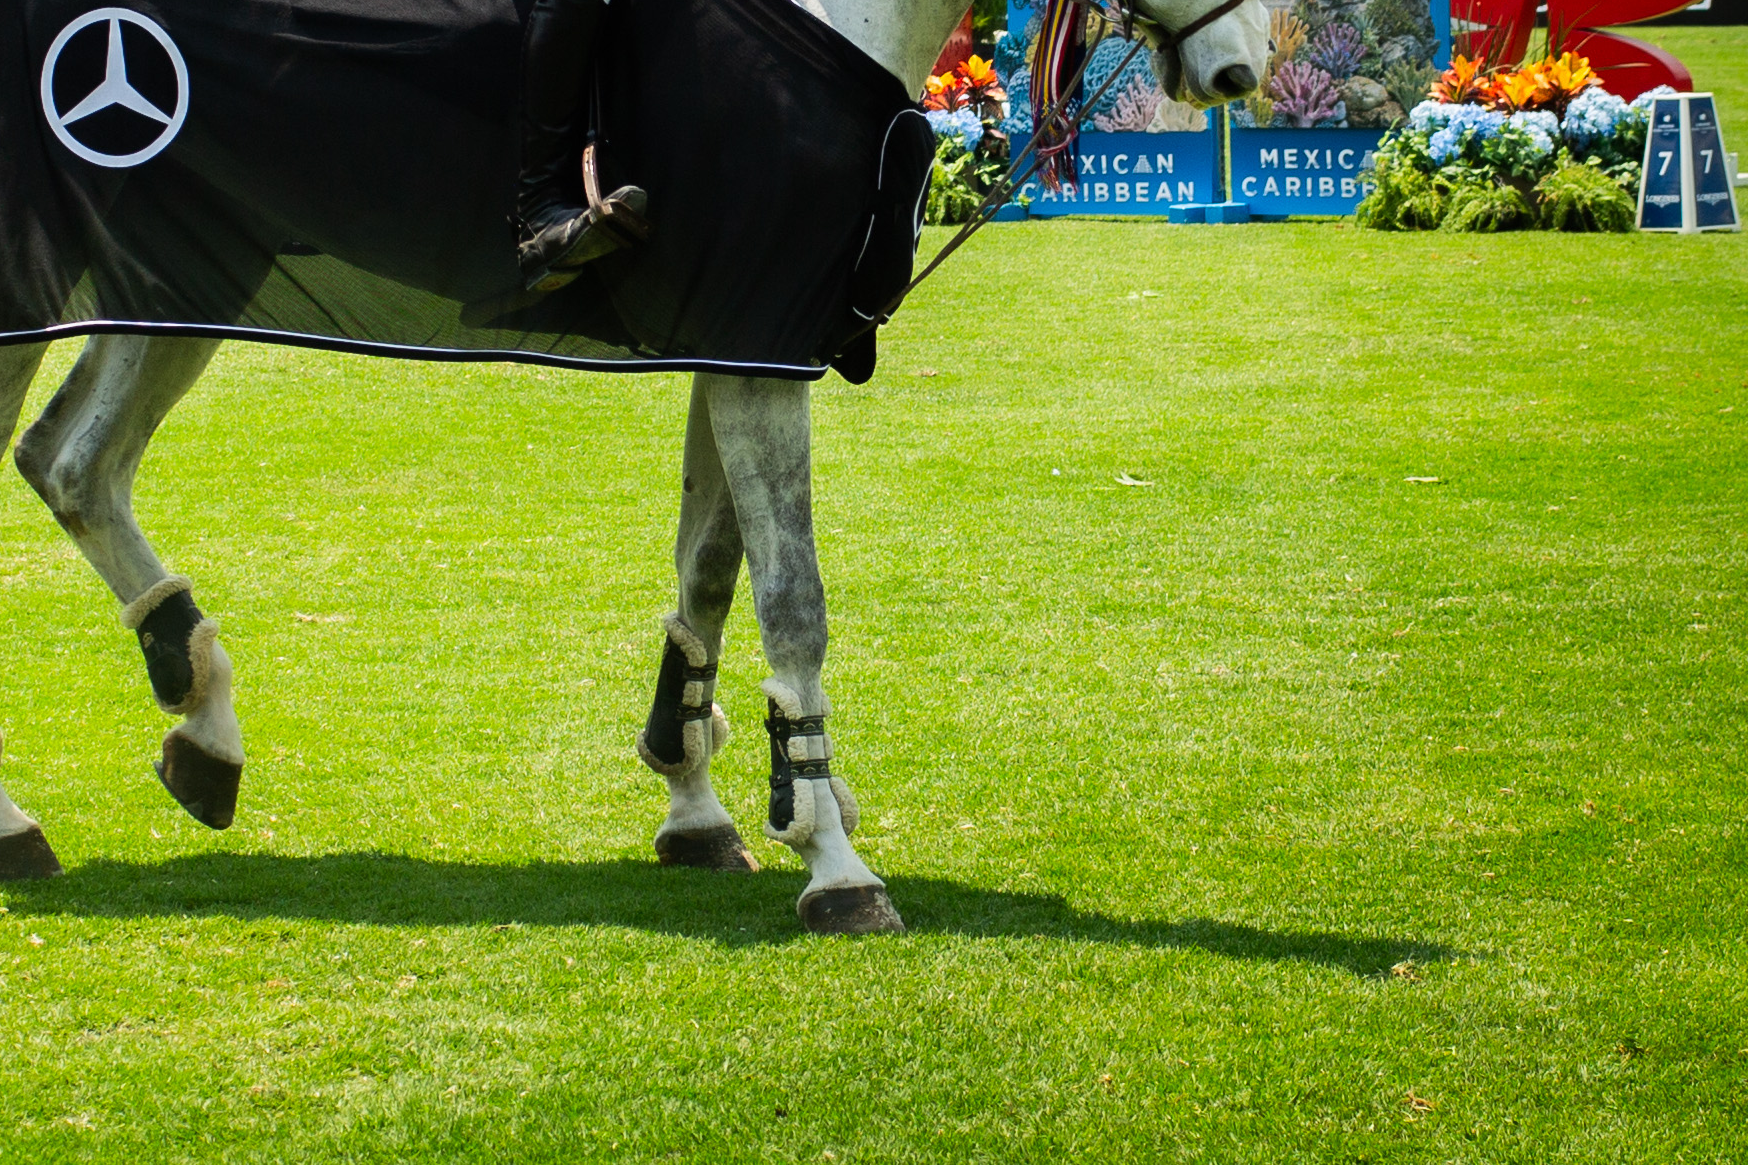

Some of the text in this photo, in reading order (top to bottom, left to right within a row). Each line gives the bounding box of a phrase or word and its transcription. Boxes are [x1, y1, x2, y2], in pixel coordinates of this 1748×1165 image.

[1051, 153, 1174, 175] XICAN
[1658, 150, 1673, 176] 7
[1700, 148, 1714, 174] 7
